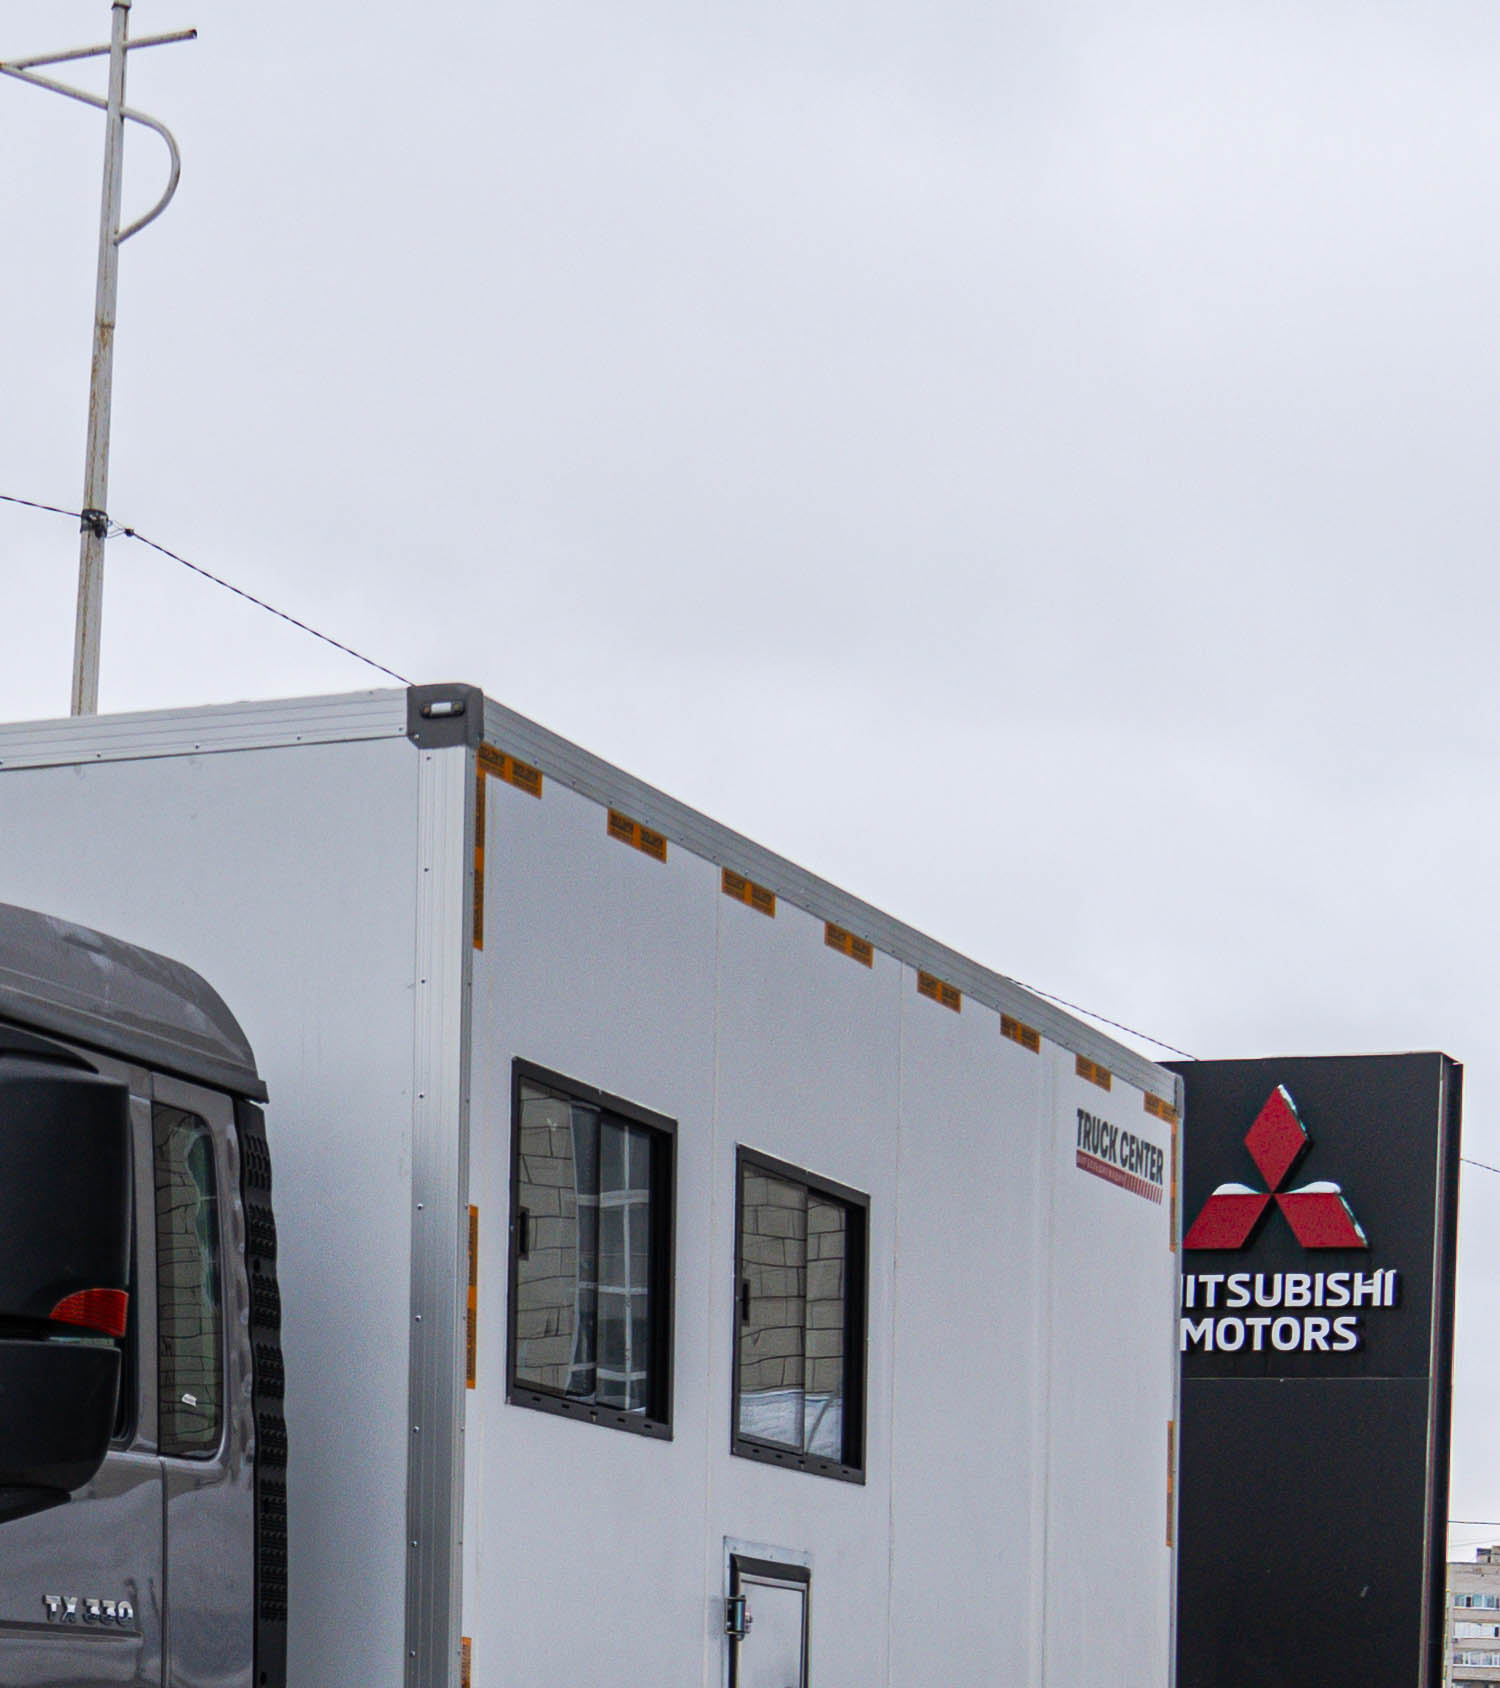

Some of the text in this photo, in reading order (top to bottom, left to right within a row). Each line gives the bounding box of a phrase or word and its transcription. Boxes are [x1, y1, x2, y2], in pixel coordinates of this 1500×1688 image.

[1077, 1107, 1118, 1164] TRUCK
[1120, 1131, 1164, 1186] CENTER
[1180, 1268, 1397, 1308] ITSUBISHI
[1179, 1316, 1358, 1352] MOTORS
